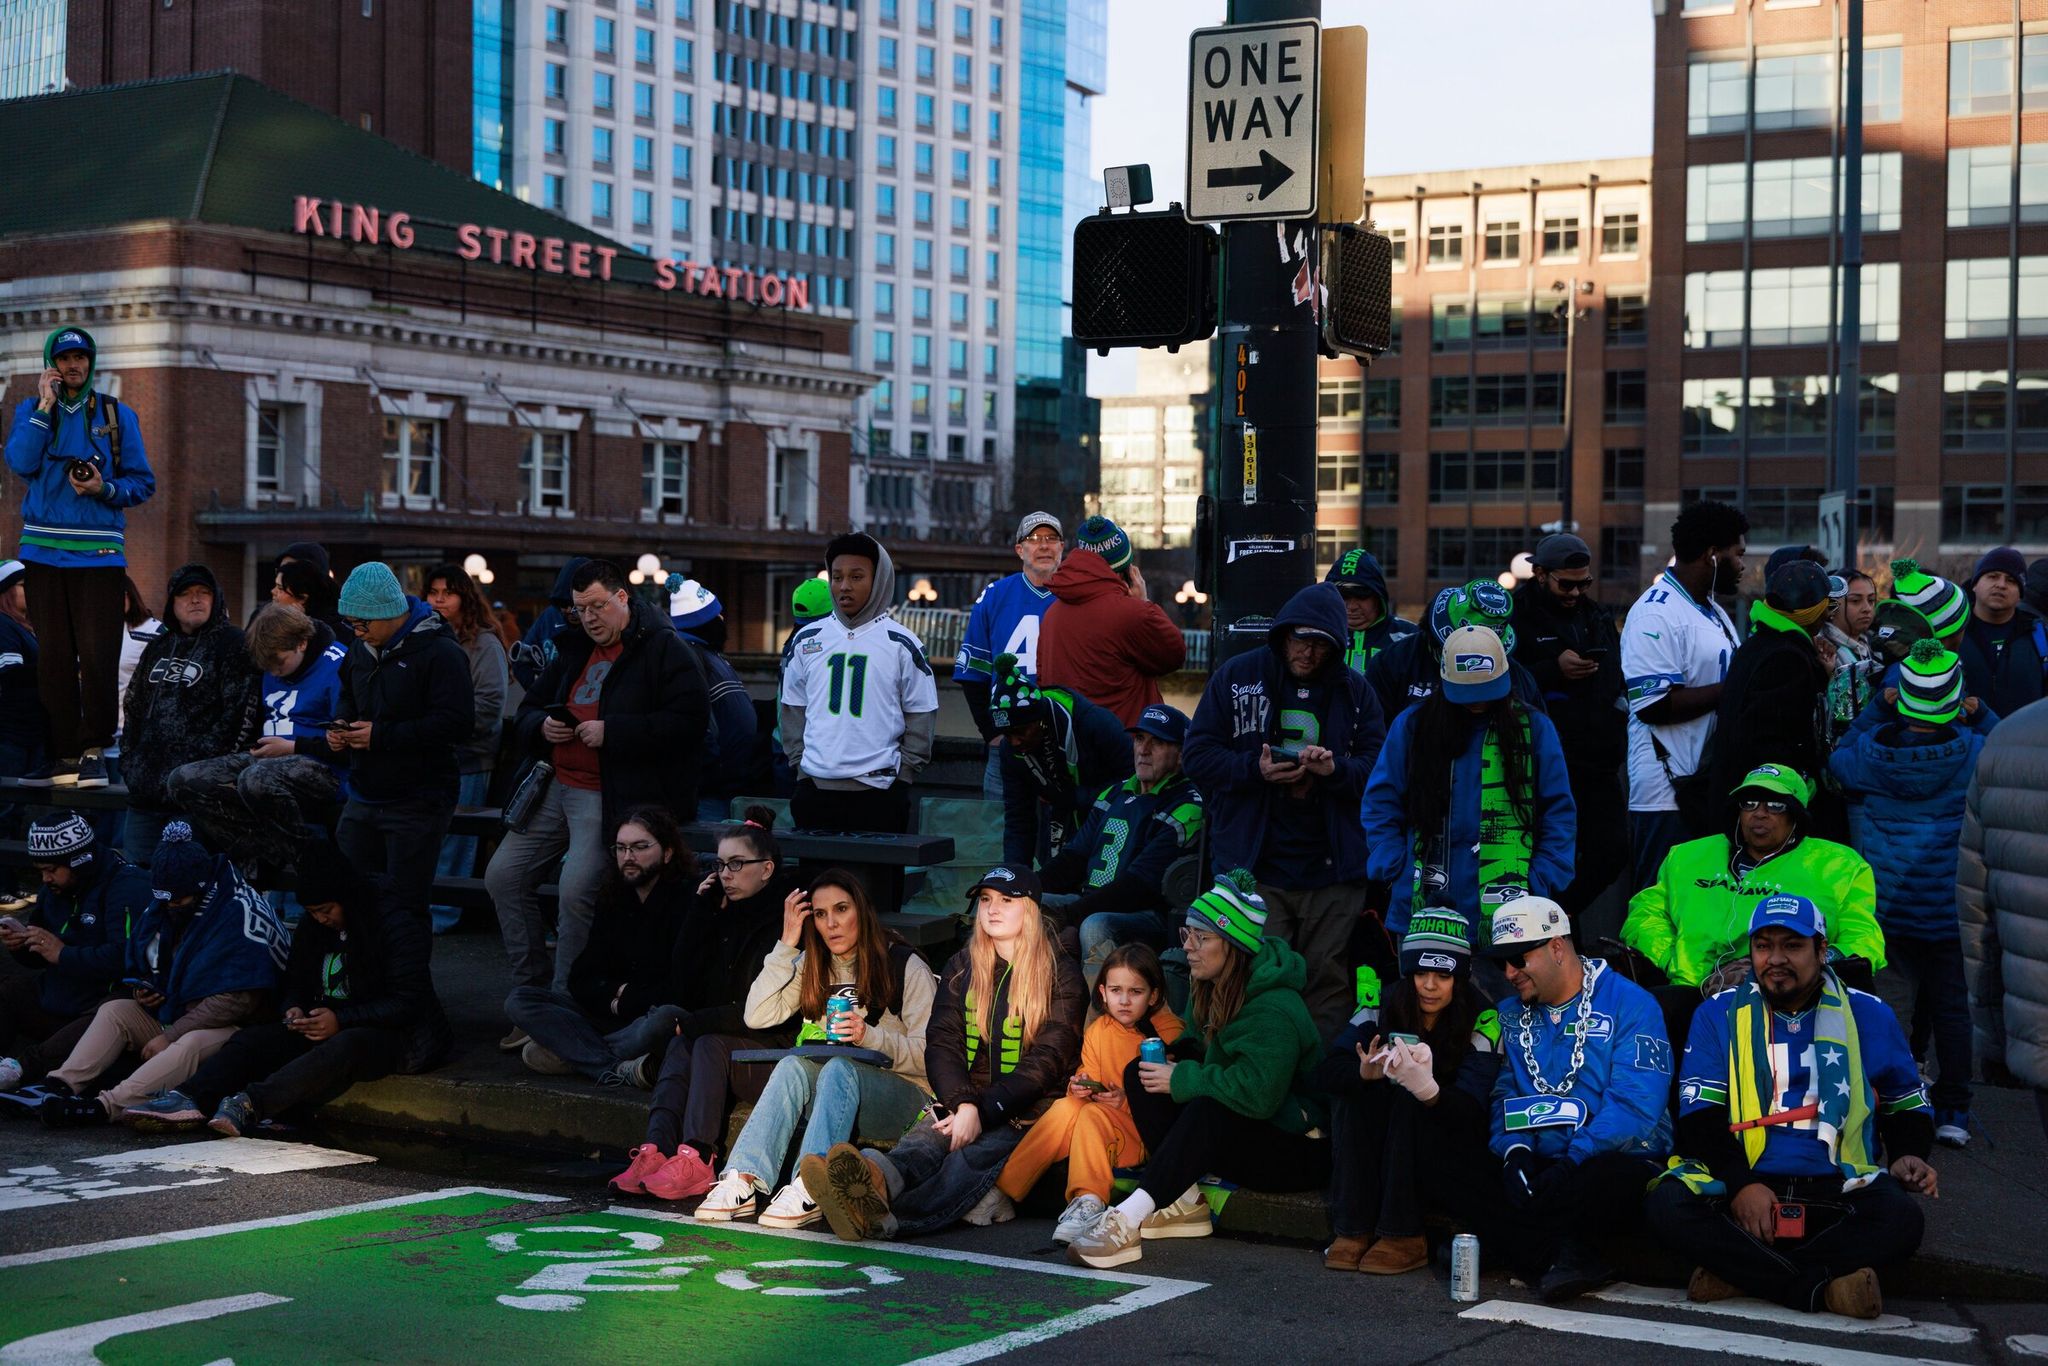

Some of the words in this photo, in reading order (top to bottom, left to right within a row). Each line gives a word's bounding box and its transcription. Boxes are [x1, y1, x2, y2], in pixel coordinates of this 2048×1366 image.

[1205, 39, 1302, 89] ONE
[1204, 93, 1304, 143] WAY
[293, 195, 415, 249] KING
[456, 222, 618, 281] STREET
[654, 258, 809, 309] STATION
[1236, 343, 1248, 417] 401
[1644, 589, 1670, 604] 11
[263, 690, 299, 736] 11
[827, 653, 868, 718] 11
[1231, 680, 1265, 699] Seattle
[1088, 817, 1131, 888] 3
[1767, 1042, 1820, 1131] 11
